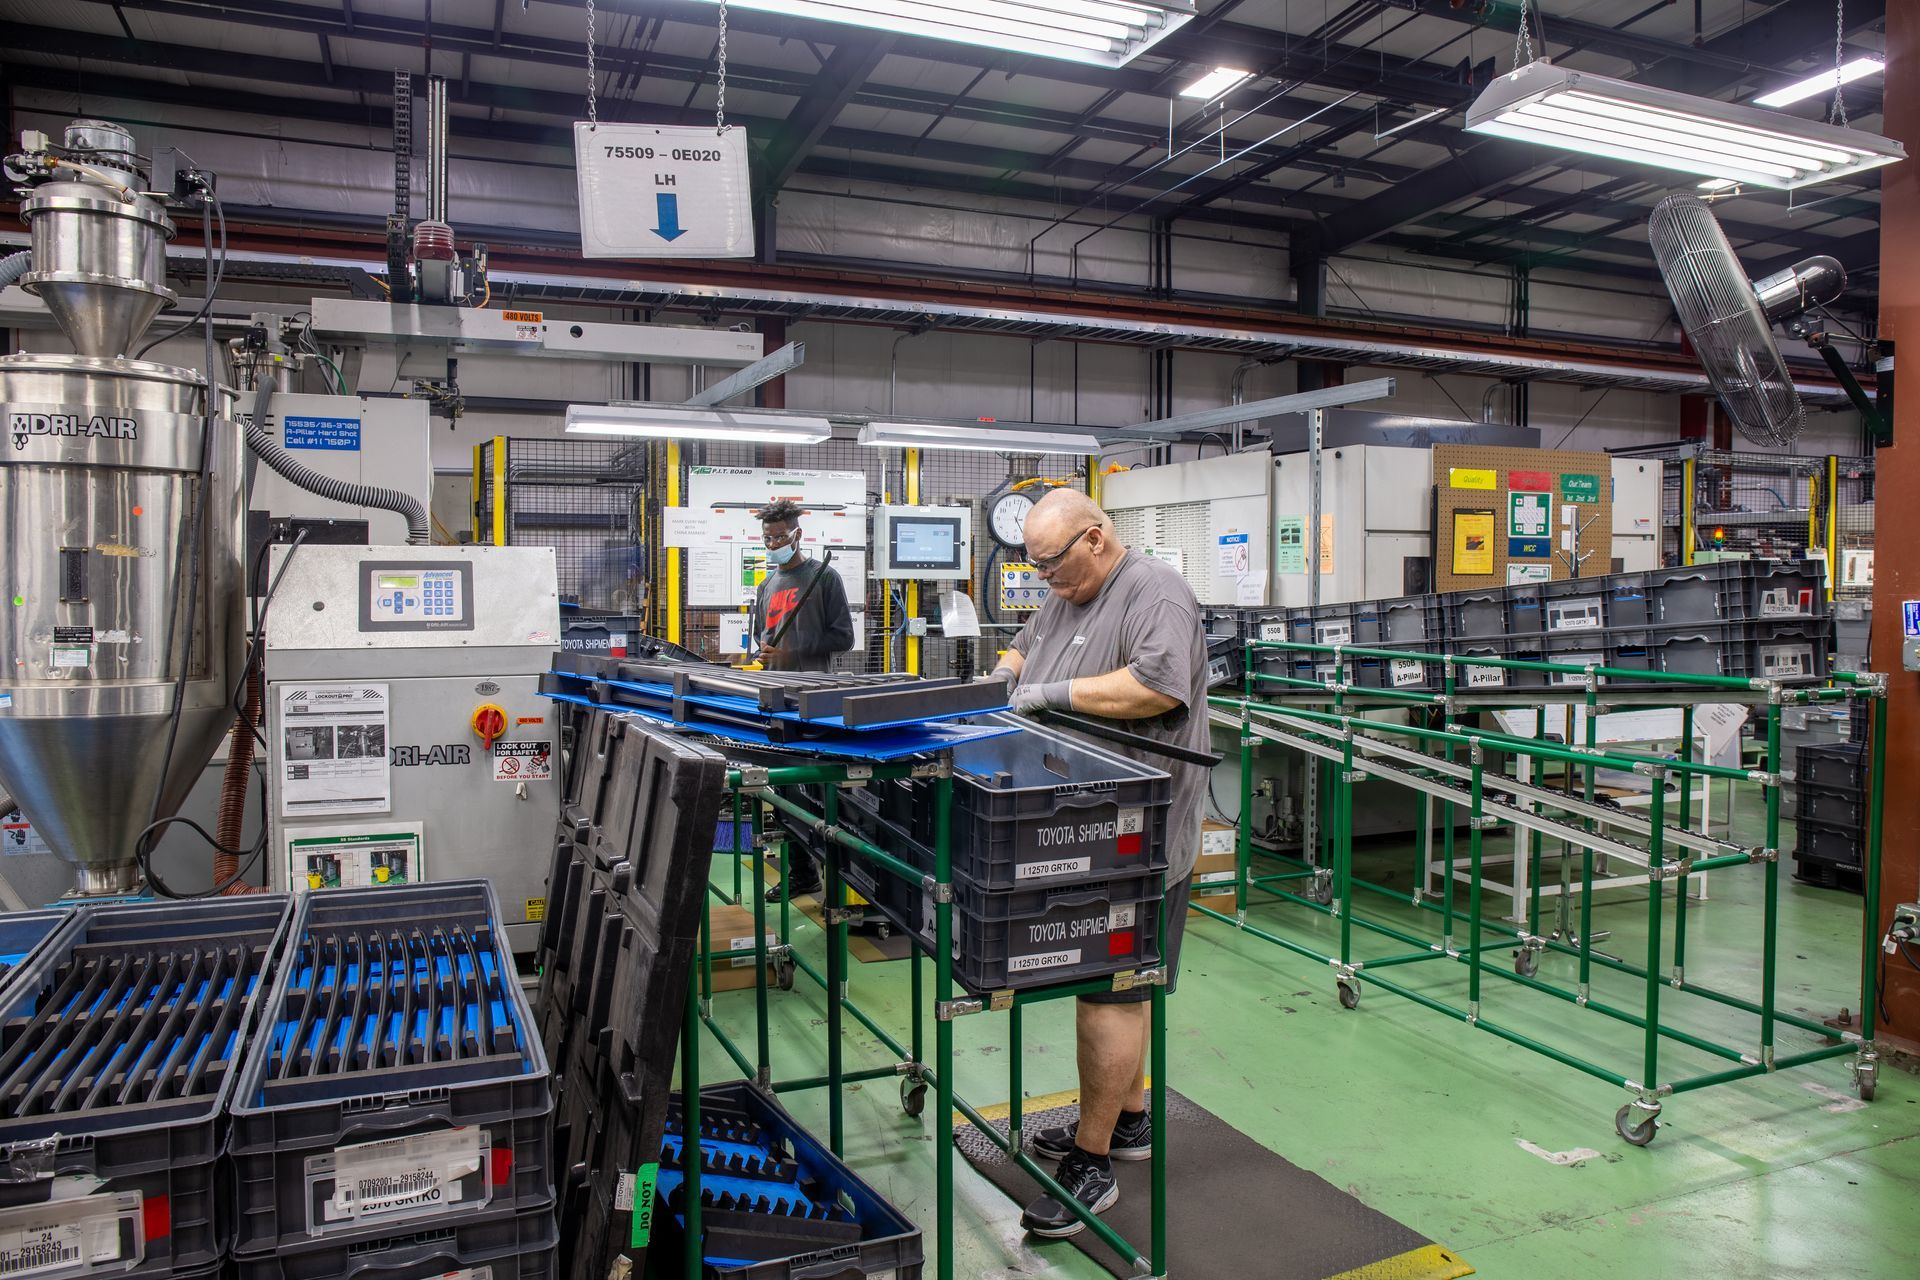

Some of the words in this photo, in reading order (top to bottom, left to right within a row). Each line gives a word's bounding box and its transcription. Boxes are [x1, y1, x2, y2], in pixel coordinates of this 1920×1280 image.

[604, 146, 654, 159] 75509
[672, 149, 721, 162] 0E020
[654, 174, 676, 186] LH
[506, 312, 518, 320] 480
[520, 312, 538, 322] VOLTS
[29, 413, 137, 440] DRI-AIR
[1464, 476, 1483, 484] Quality
[769, 588, 800, 609] NIKE
[562, 639, 584, 650] TOYOTA
[586, 638, 611, 649] SHIPMEN
[1398, 660, 1416, 669] 550B
[1397, 672, 1421, 682] A-Pillar
[1473, 675, 1501, 683] A-Pillar
[1037, 826, 1075, 847] TOYOTA
[1078, 821, 1122, 843] SHIPMEN
[1028, 865, 1050, 875] 12570
[1050, 862, 1078, 872] GRTKO
[1029, 921, 1066, 943] TOYOTA
[1070, 916, 1114, 939] SHIPMEN
[1018, 958, 1040, 968] 12570
[1041, 955, 1068, 965] GRTKO
[642, 1181, 652, 1208] NOT
[362, 1200, 392, 1212] 2570
[641, 1211, 650, 1230] DO
[42, 1232, 52, 1243] 24
